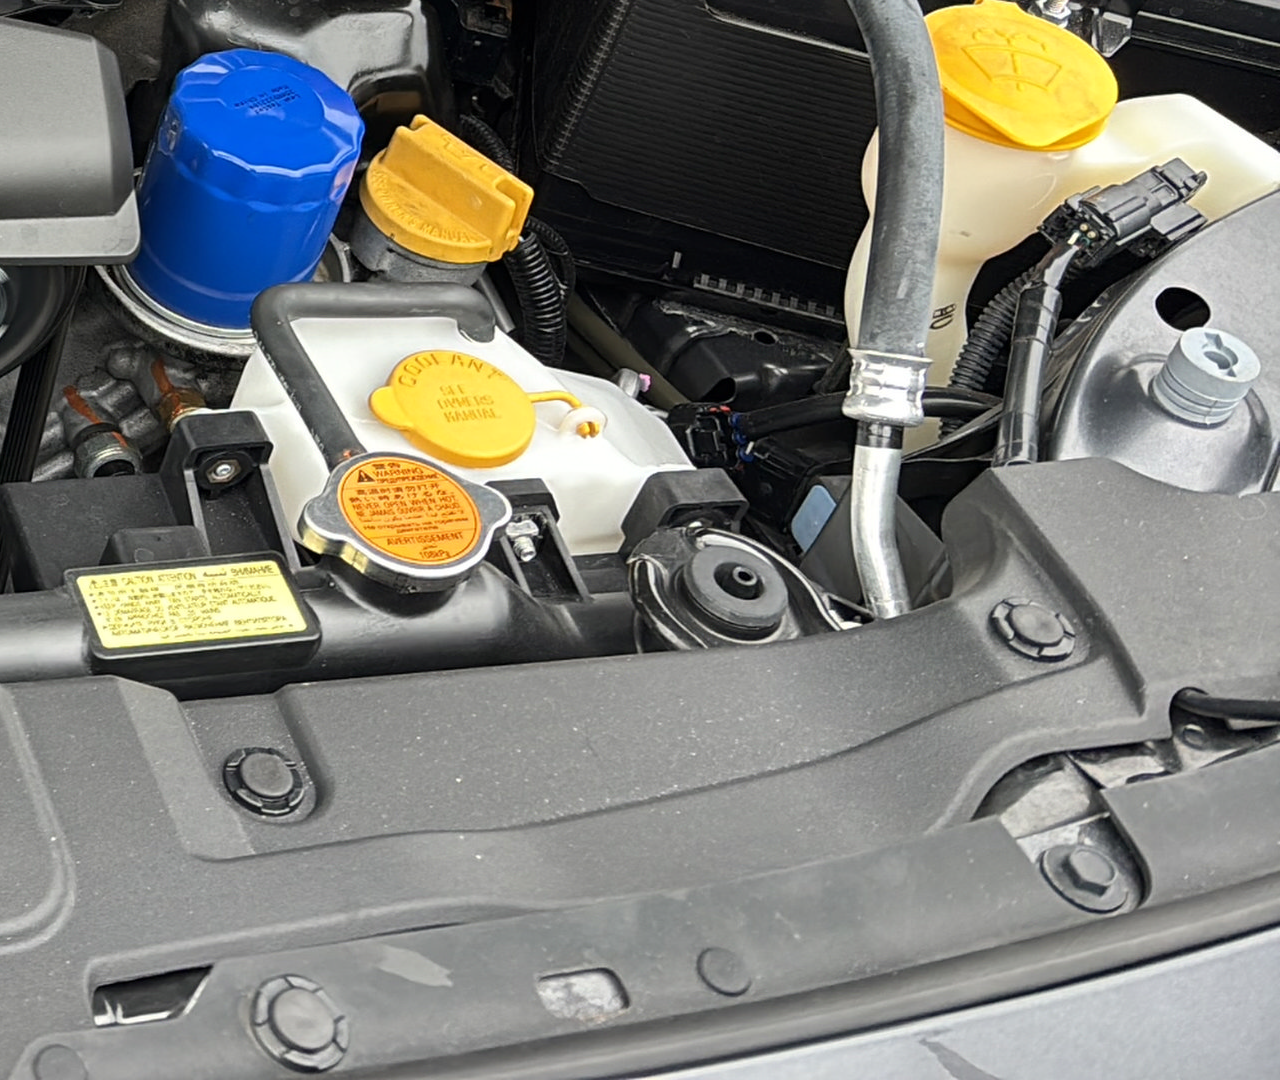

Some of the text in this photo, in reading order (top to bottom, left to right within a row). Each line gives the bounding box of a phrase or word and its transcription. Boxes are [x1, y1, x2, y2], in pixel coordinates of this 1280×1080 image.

[398, 352, 507, 388] COOLANT
[372, 467, 425, 478] WARNING
[387, 531, 464, 546] AVERTISSEMENT
